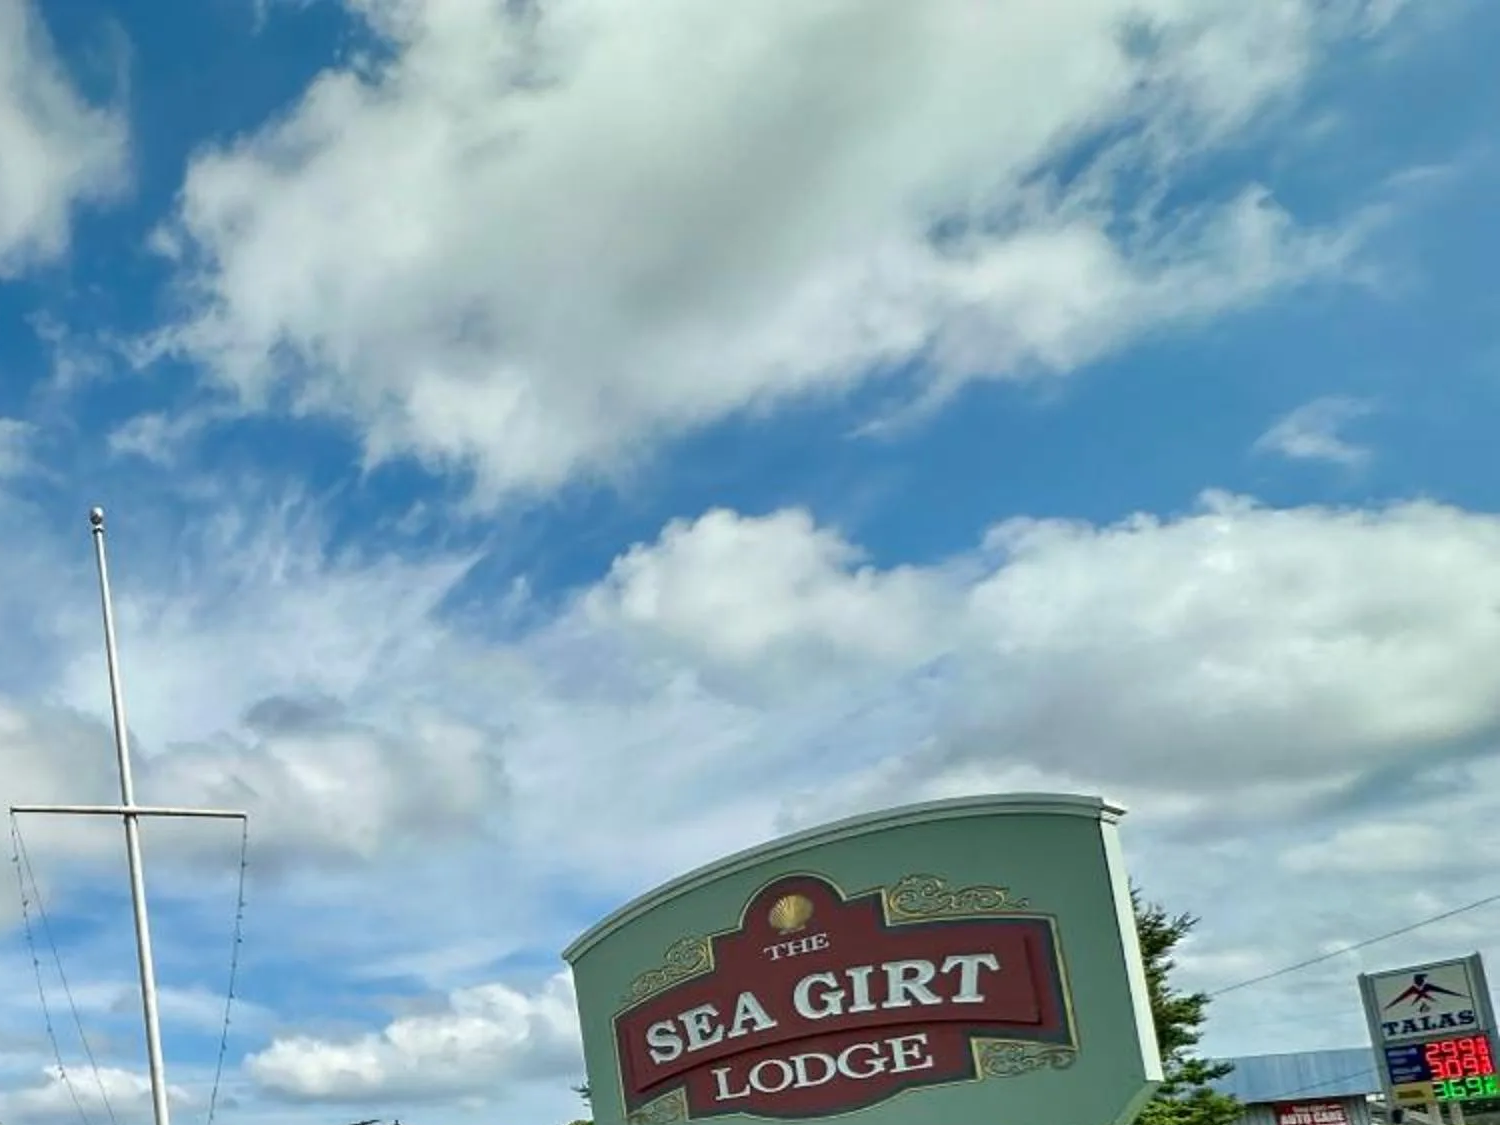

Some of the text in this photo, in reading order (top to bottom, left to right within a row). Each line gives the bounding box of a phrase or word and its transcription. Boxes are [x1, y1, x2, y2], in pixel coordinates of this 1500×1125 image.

[763, 932, 830, 961] THE
[645, 952, 1000, 1066] SEA GIRT
[1381, 1009, 1476, 1037] TALAS
[711, 1032, 934, 1102] LODGE
